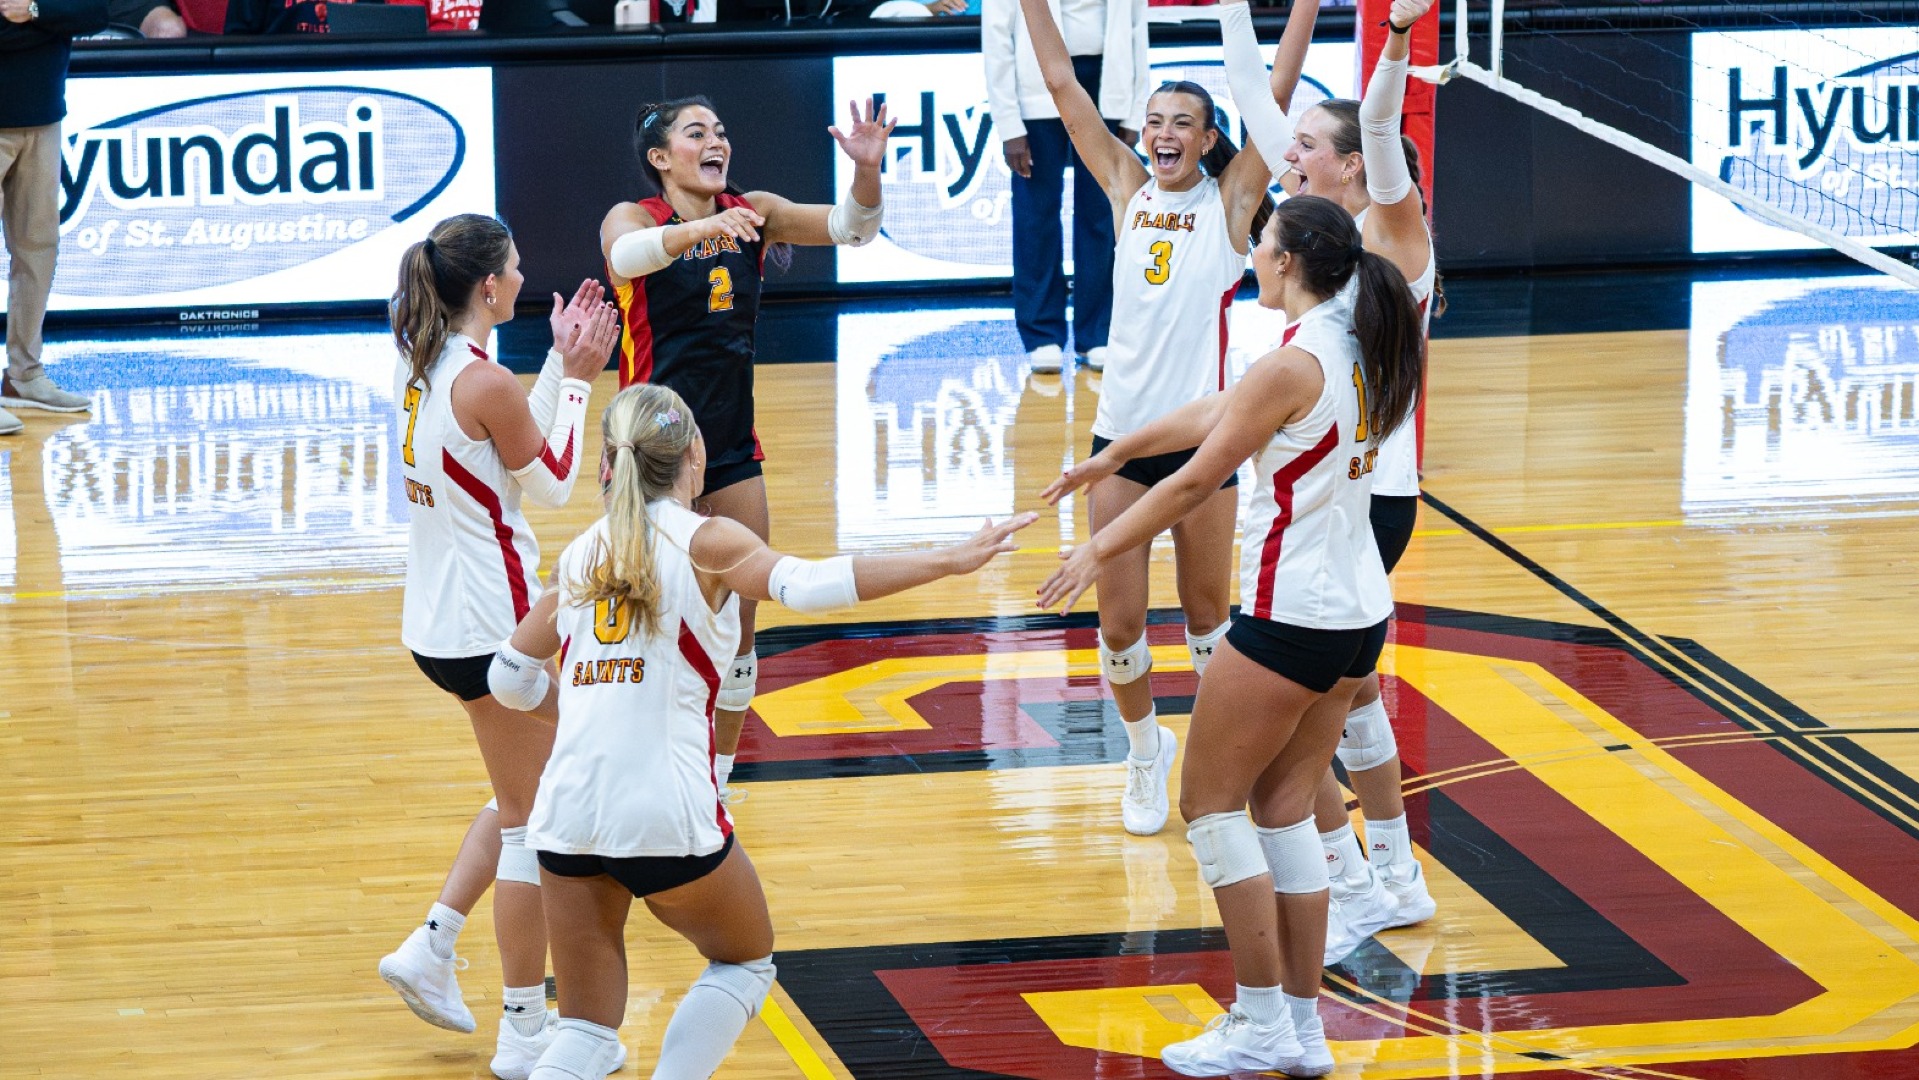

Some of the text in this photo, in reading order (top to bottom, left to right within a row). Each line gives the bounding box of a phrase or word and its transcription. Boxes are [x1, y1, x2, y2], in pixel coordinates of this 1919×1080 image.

[1729, 66, 1919, 170] Hyu
[60, 106, 374, 226] yundai
[77, 213, 369, 256] of St. Augustine
[1144, 240, 1173, 285] 3
[708, 265, 735, 313] 2
[180, 310, 260, 320] DAKTRONICS
[402, 384, 422, 468] 7
[572, 657, 645, 687] SAINTS
